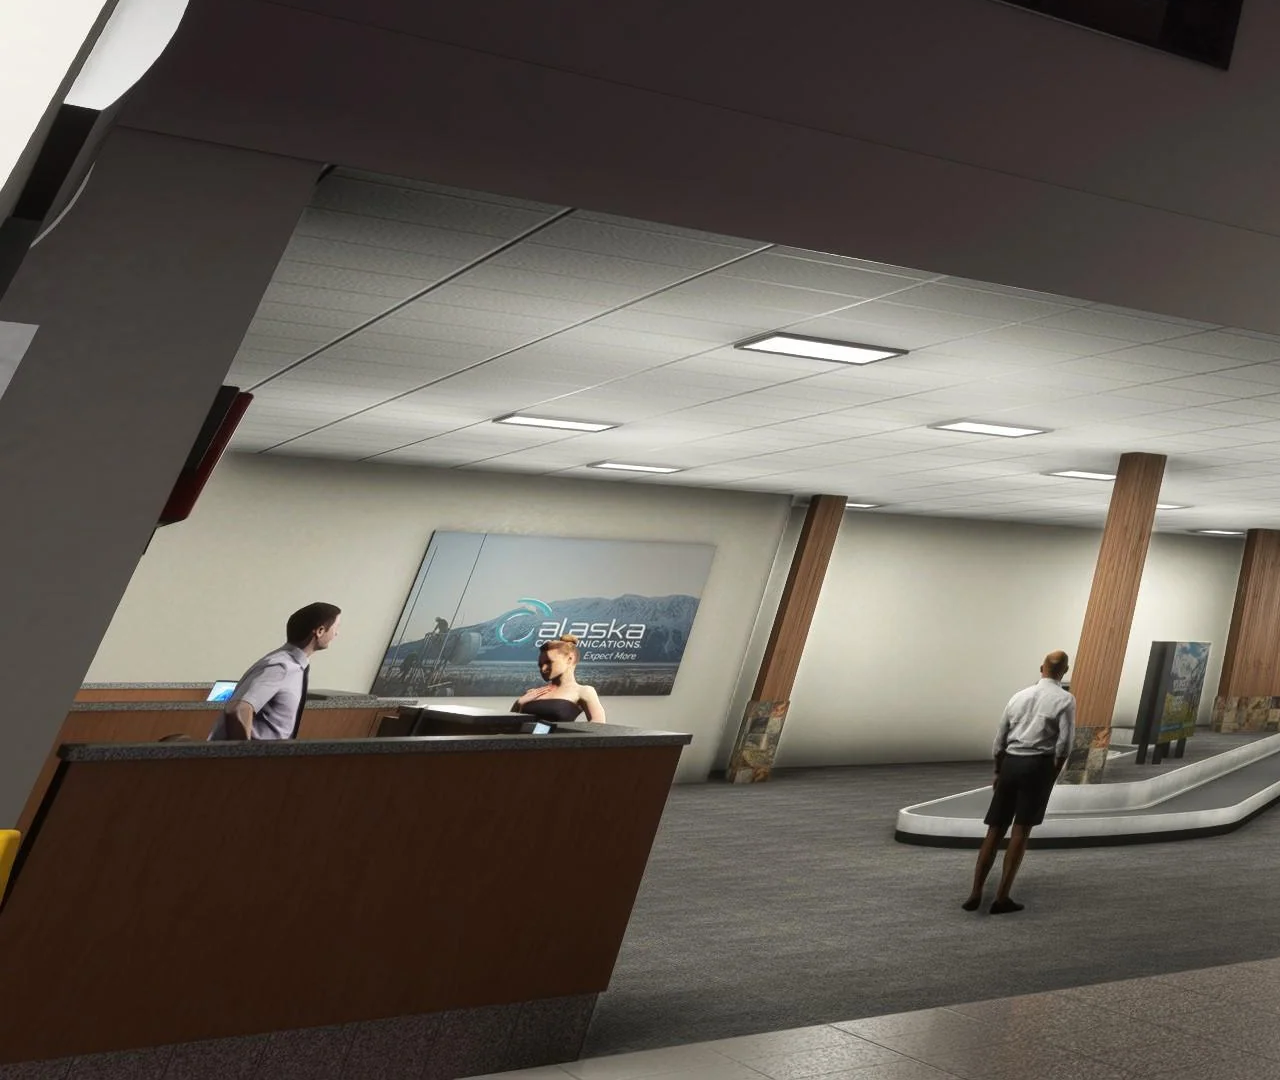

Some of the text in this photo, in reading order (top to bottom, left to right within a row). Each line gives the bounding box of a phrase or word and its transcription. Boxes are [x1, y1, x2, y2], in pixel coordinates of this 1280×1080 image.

[538, 618, 646, 639] alaska
[583, 651, 637, 661] Expect More
